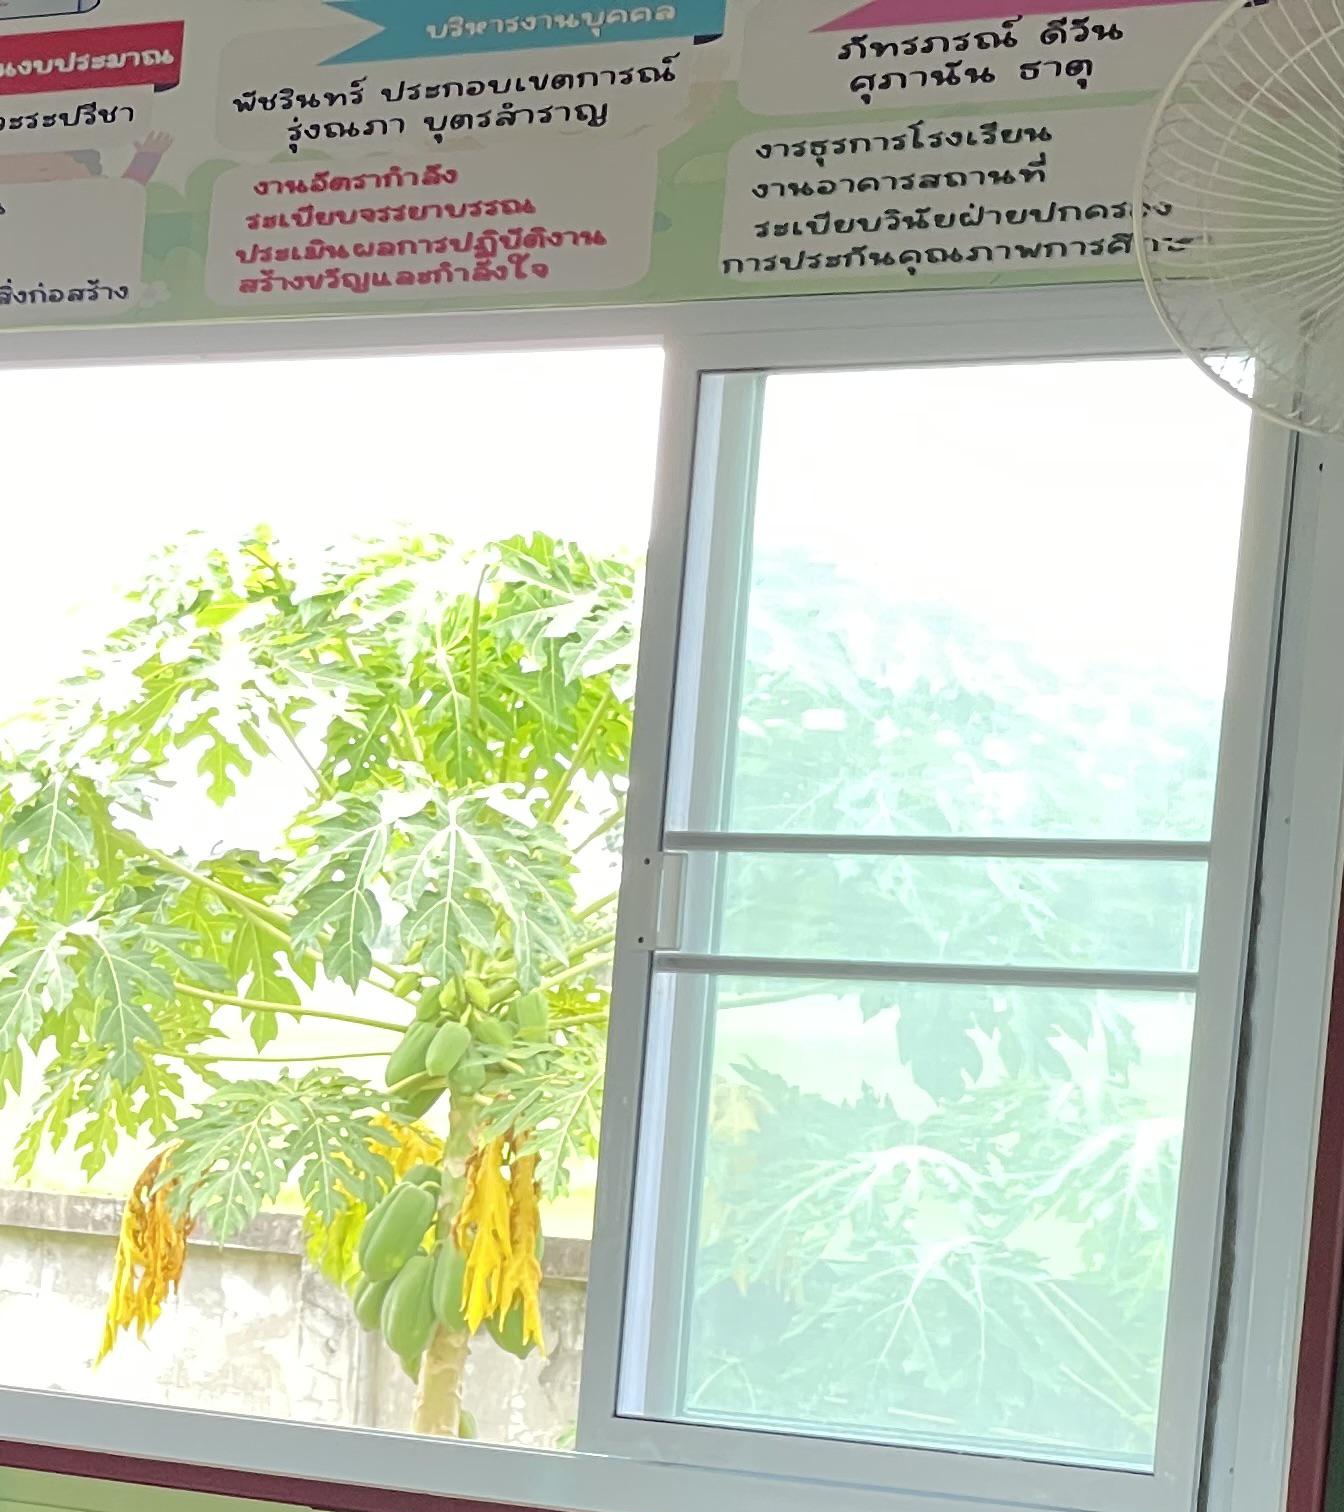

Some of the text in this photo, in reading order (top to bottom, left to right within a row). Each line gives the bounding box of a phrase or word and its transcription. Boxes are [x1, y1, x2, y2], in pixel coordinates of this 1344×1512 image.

[426, 3, 677, 39] บริหารงานบุคคล
[838, 15, 1124, 60] ภัทรภรณ์ ดีวัน
[232, 76, 369, 114] พัชรินทร์
[850, 58, 1094, 105] ศุภานัน ธาตุ
[286, 101, 608, 154] รุ่งณภา บุตรสำราญ
[253, 163, 458, 196] งานอัตรากำลัง
[752, 152, 1048, 198] งานอาคารสถานที่
[246, 199, 536, 230] ระเบียบจรรยาบรรณ
[235, 226, 607, 265] ประเมินผลการปฏิบัติงาน
[238, 253, 550, 294] สร้างขวัญและกำลังใจ
